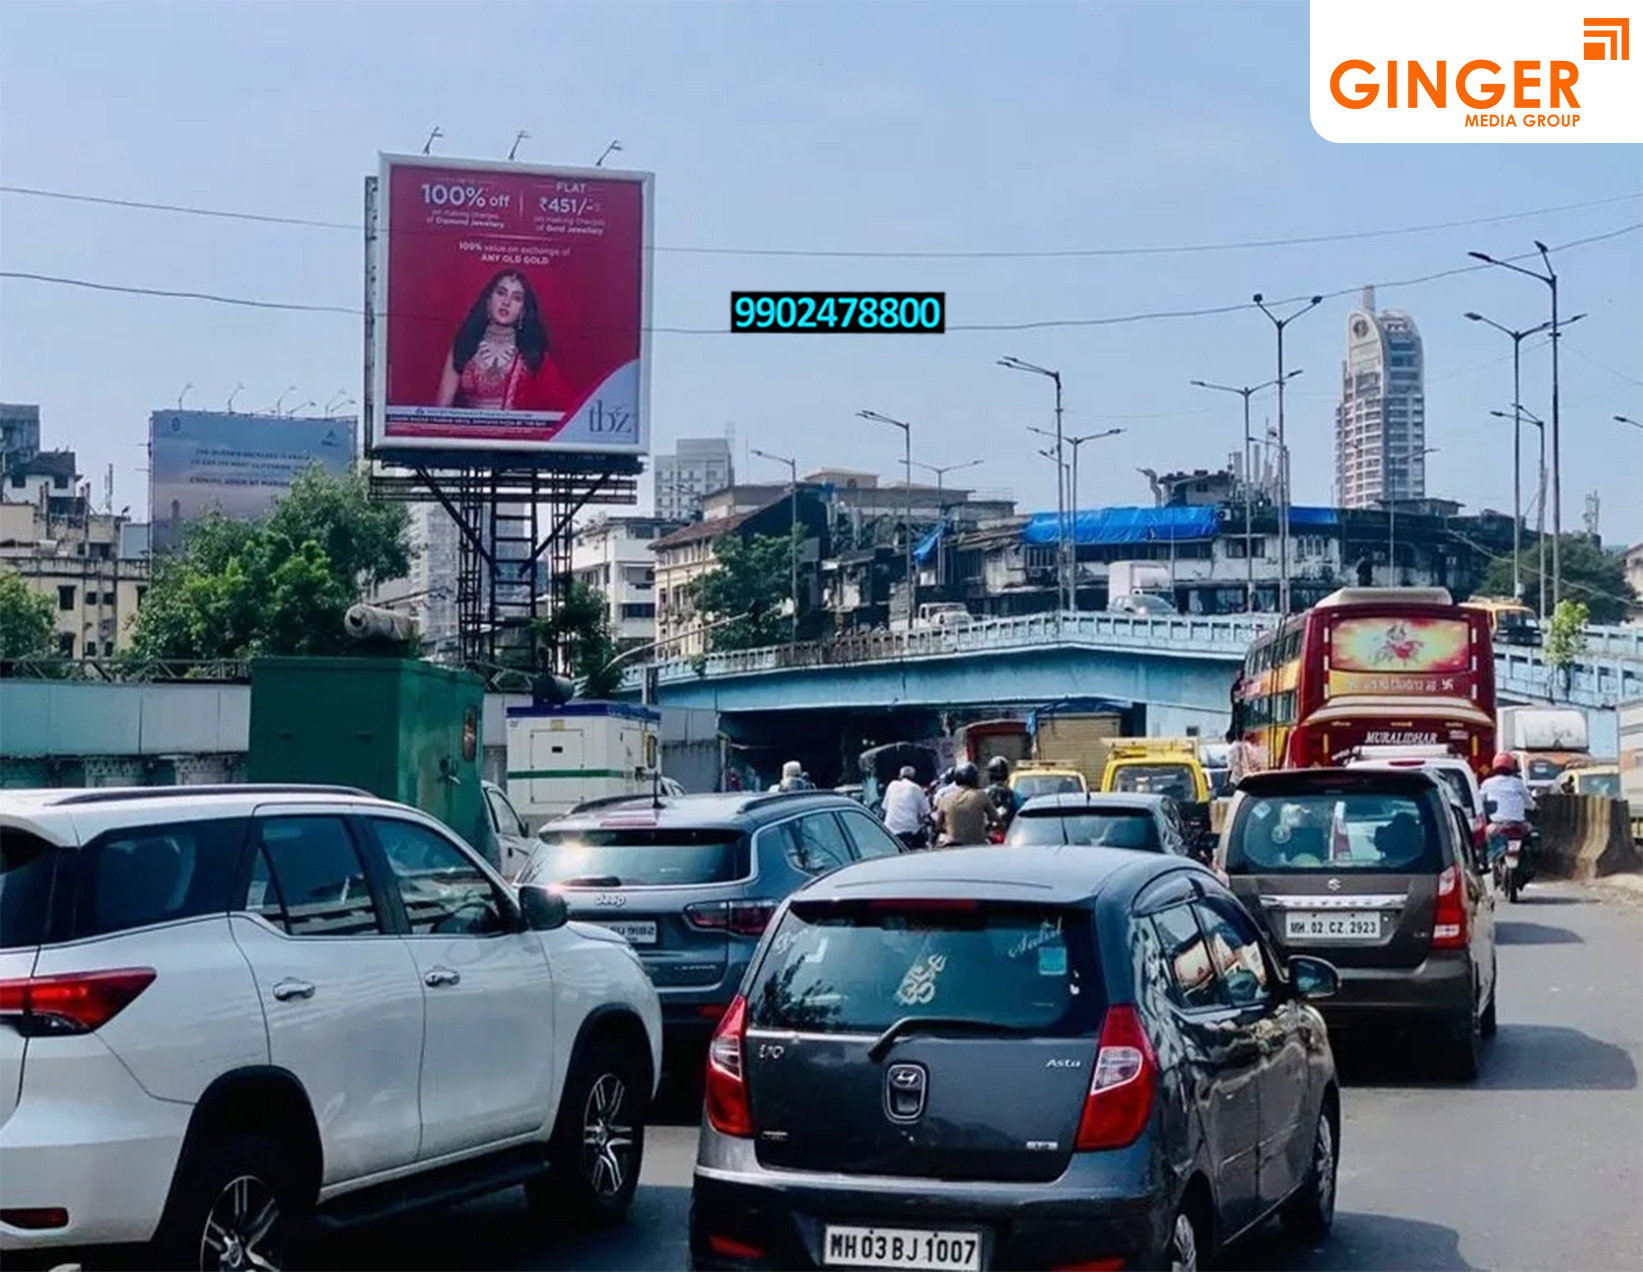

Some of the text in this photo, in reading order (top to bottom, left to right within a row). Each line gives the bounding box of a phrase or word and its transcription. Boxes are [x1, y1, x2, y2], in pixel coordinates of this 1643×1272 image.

[556, 182, 586, 193] FLAT
[489, 194, 510, 207] off
[459, 241, 481, 252] 100%
[481, 253, 550, 265] ANY OLD GOLD
[1365, 731, 1438, 745] MURALIDHAR
[830, 1233, 977, 1265] MH 03 BJ 1007
